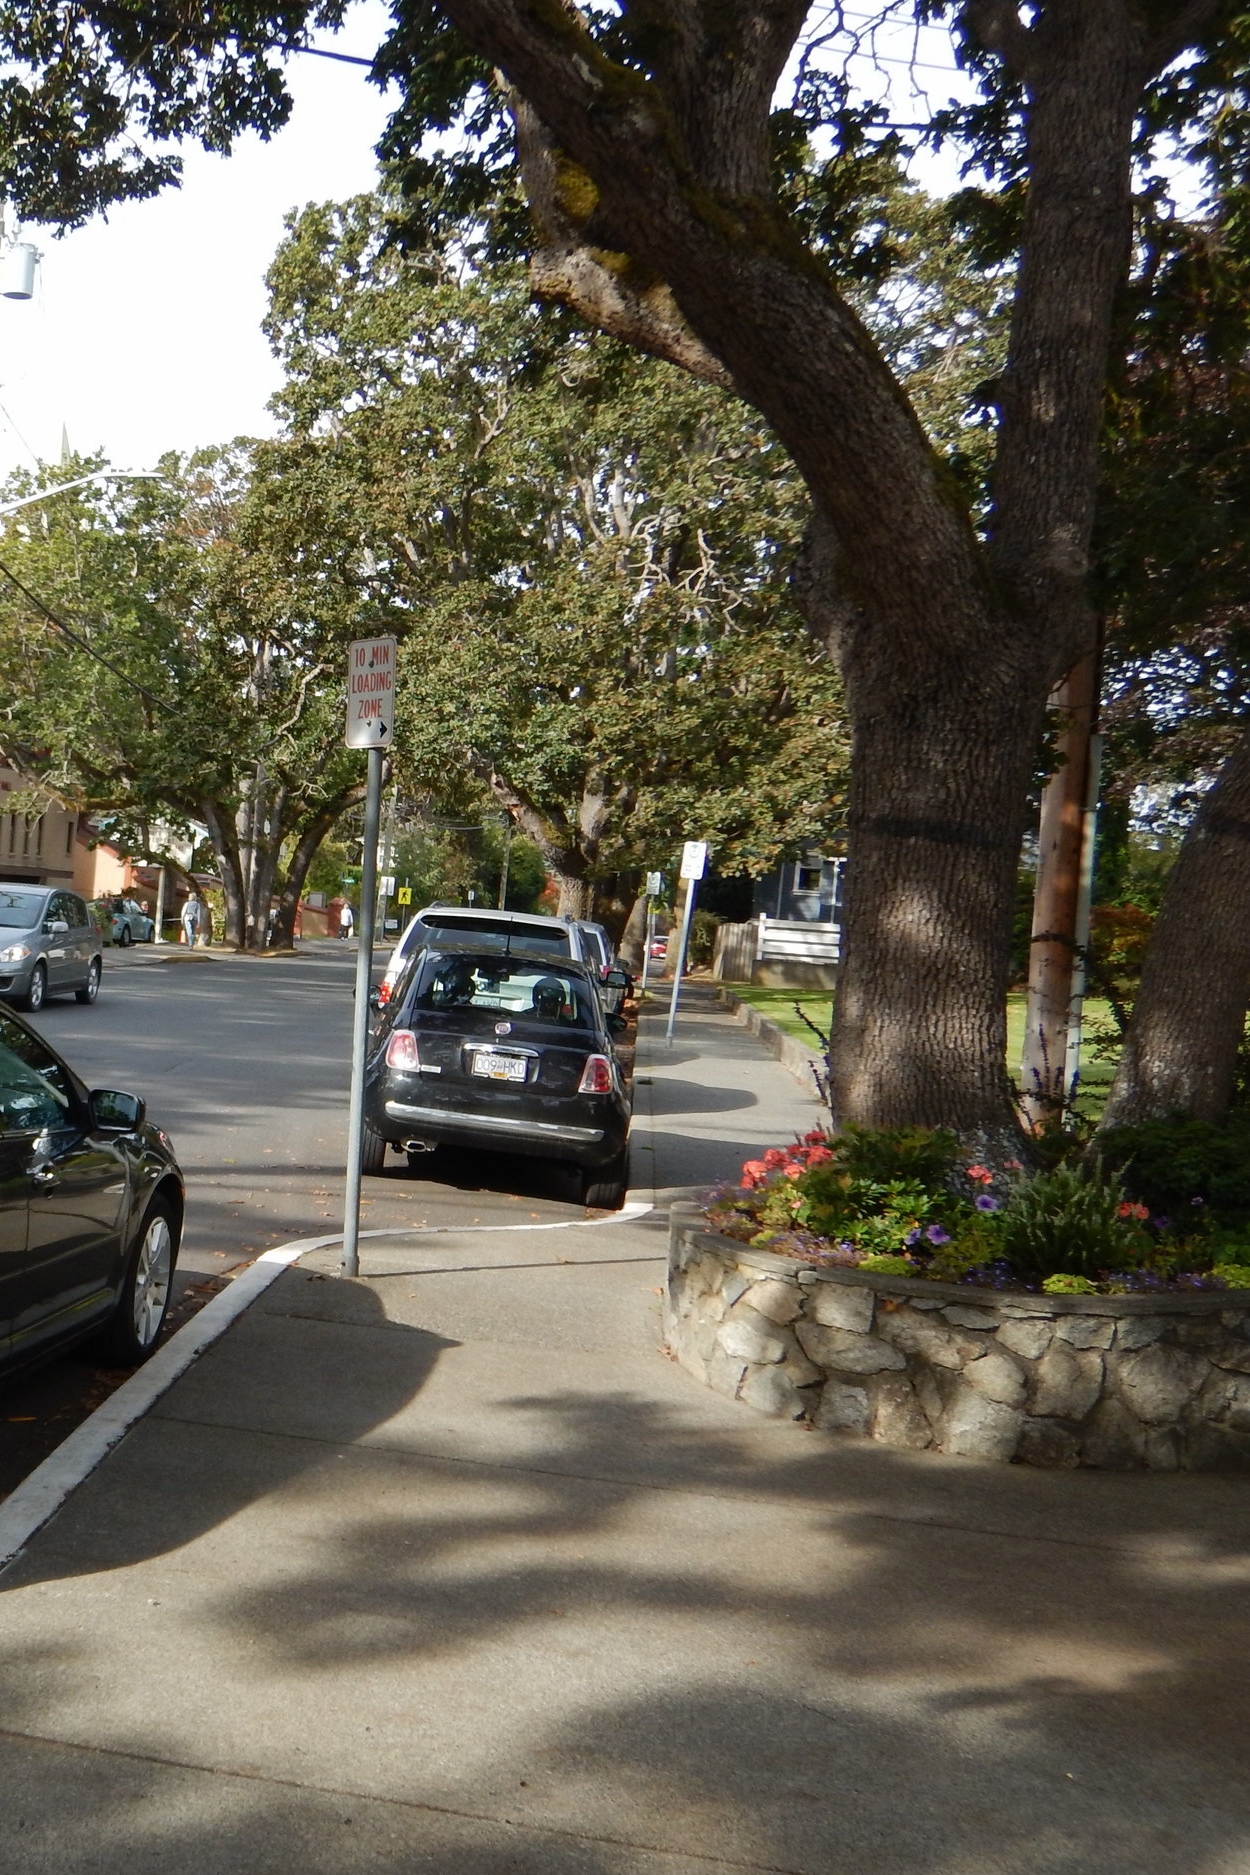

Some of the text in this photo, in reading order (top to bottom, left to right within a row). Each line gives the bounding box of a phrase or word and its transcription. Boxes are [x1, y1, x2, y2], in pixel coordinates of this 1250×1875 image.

[355, 644, 390, 668] 10 MIN
[351, 671, 392, 694] LOADING
[357, 698, 383, 719] ZONE
